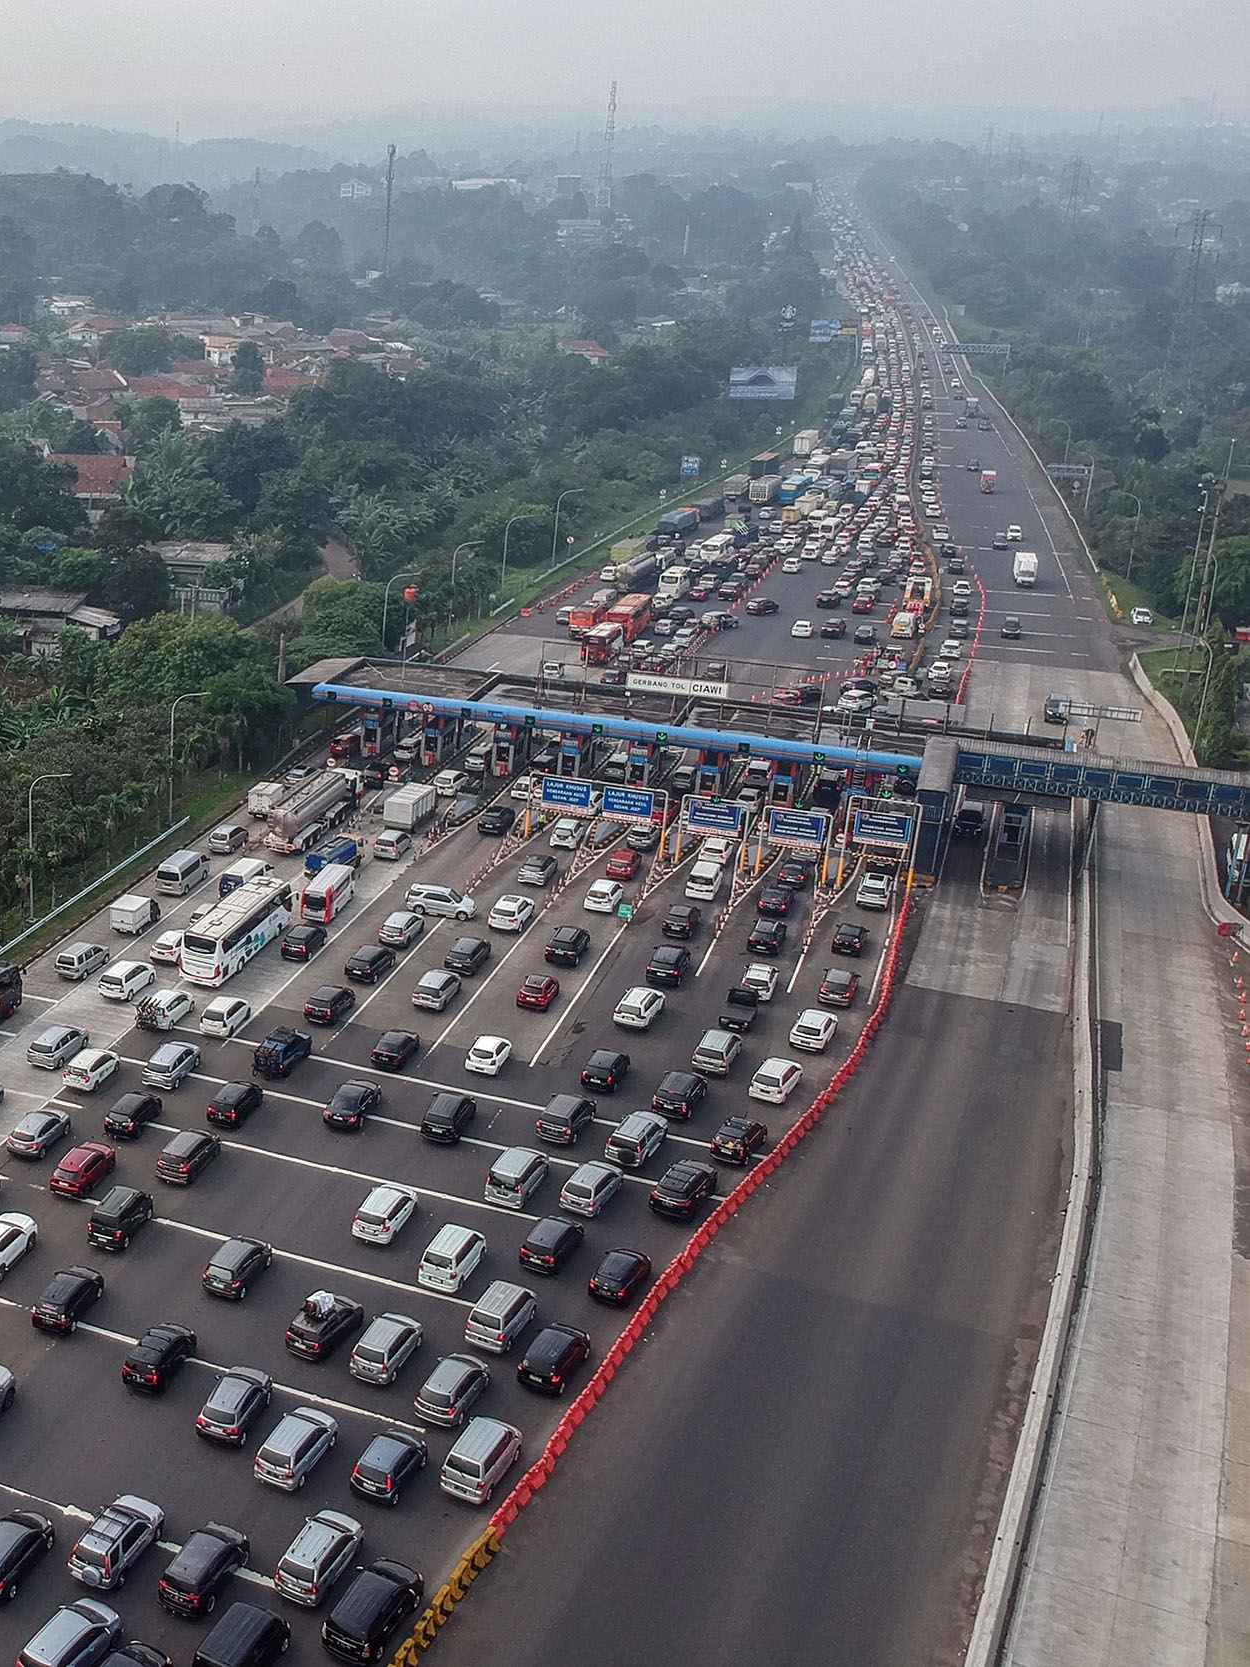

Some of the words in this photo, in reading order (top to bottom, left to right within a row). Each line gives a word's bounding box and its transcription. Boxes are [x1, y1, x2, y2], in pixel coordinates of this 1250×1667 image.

[632, 678, 668, 688] GERBANG
[671, 682, 686, 690] TOL
[692, 684, 722, 695] CIAWI
